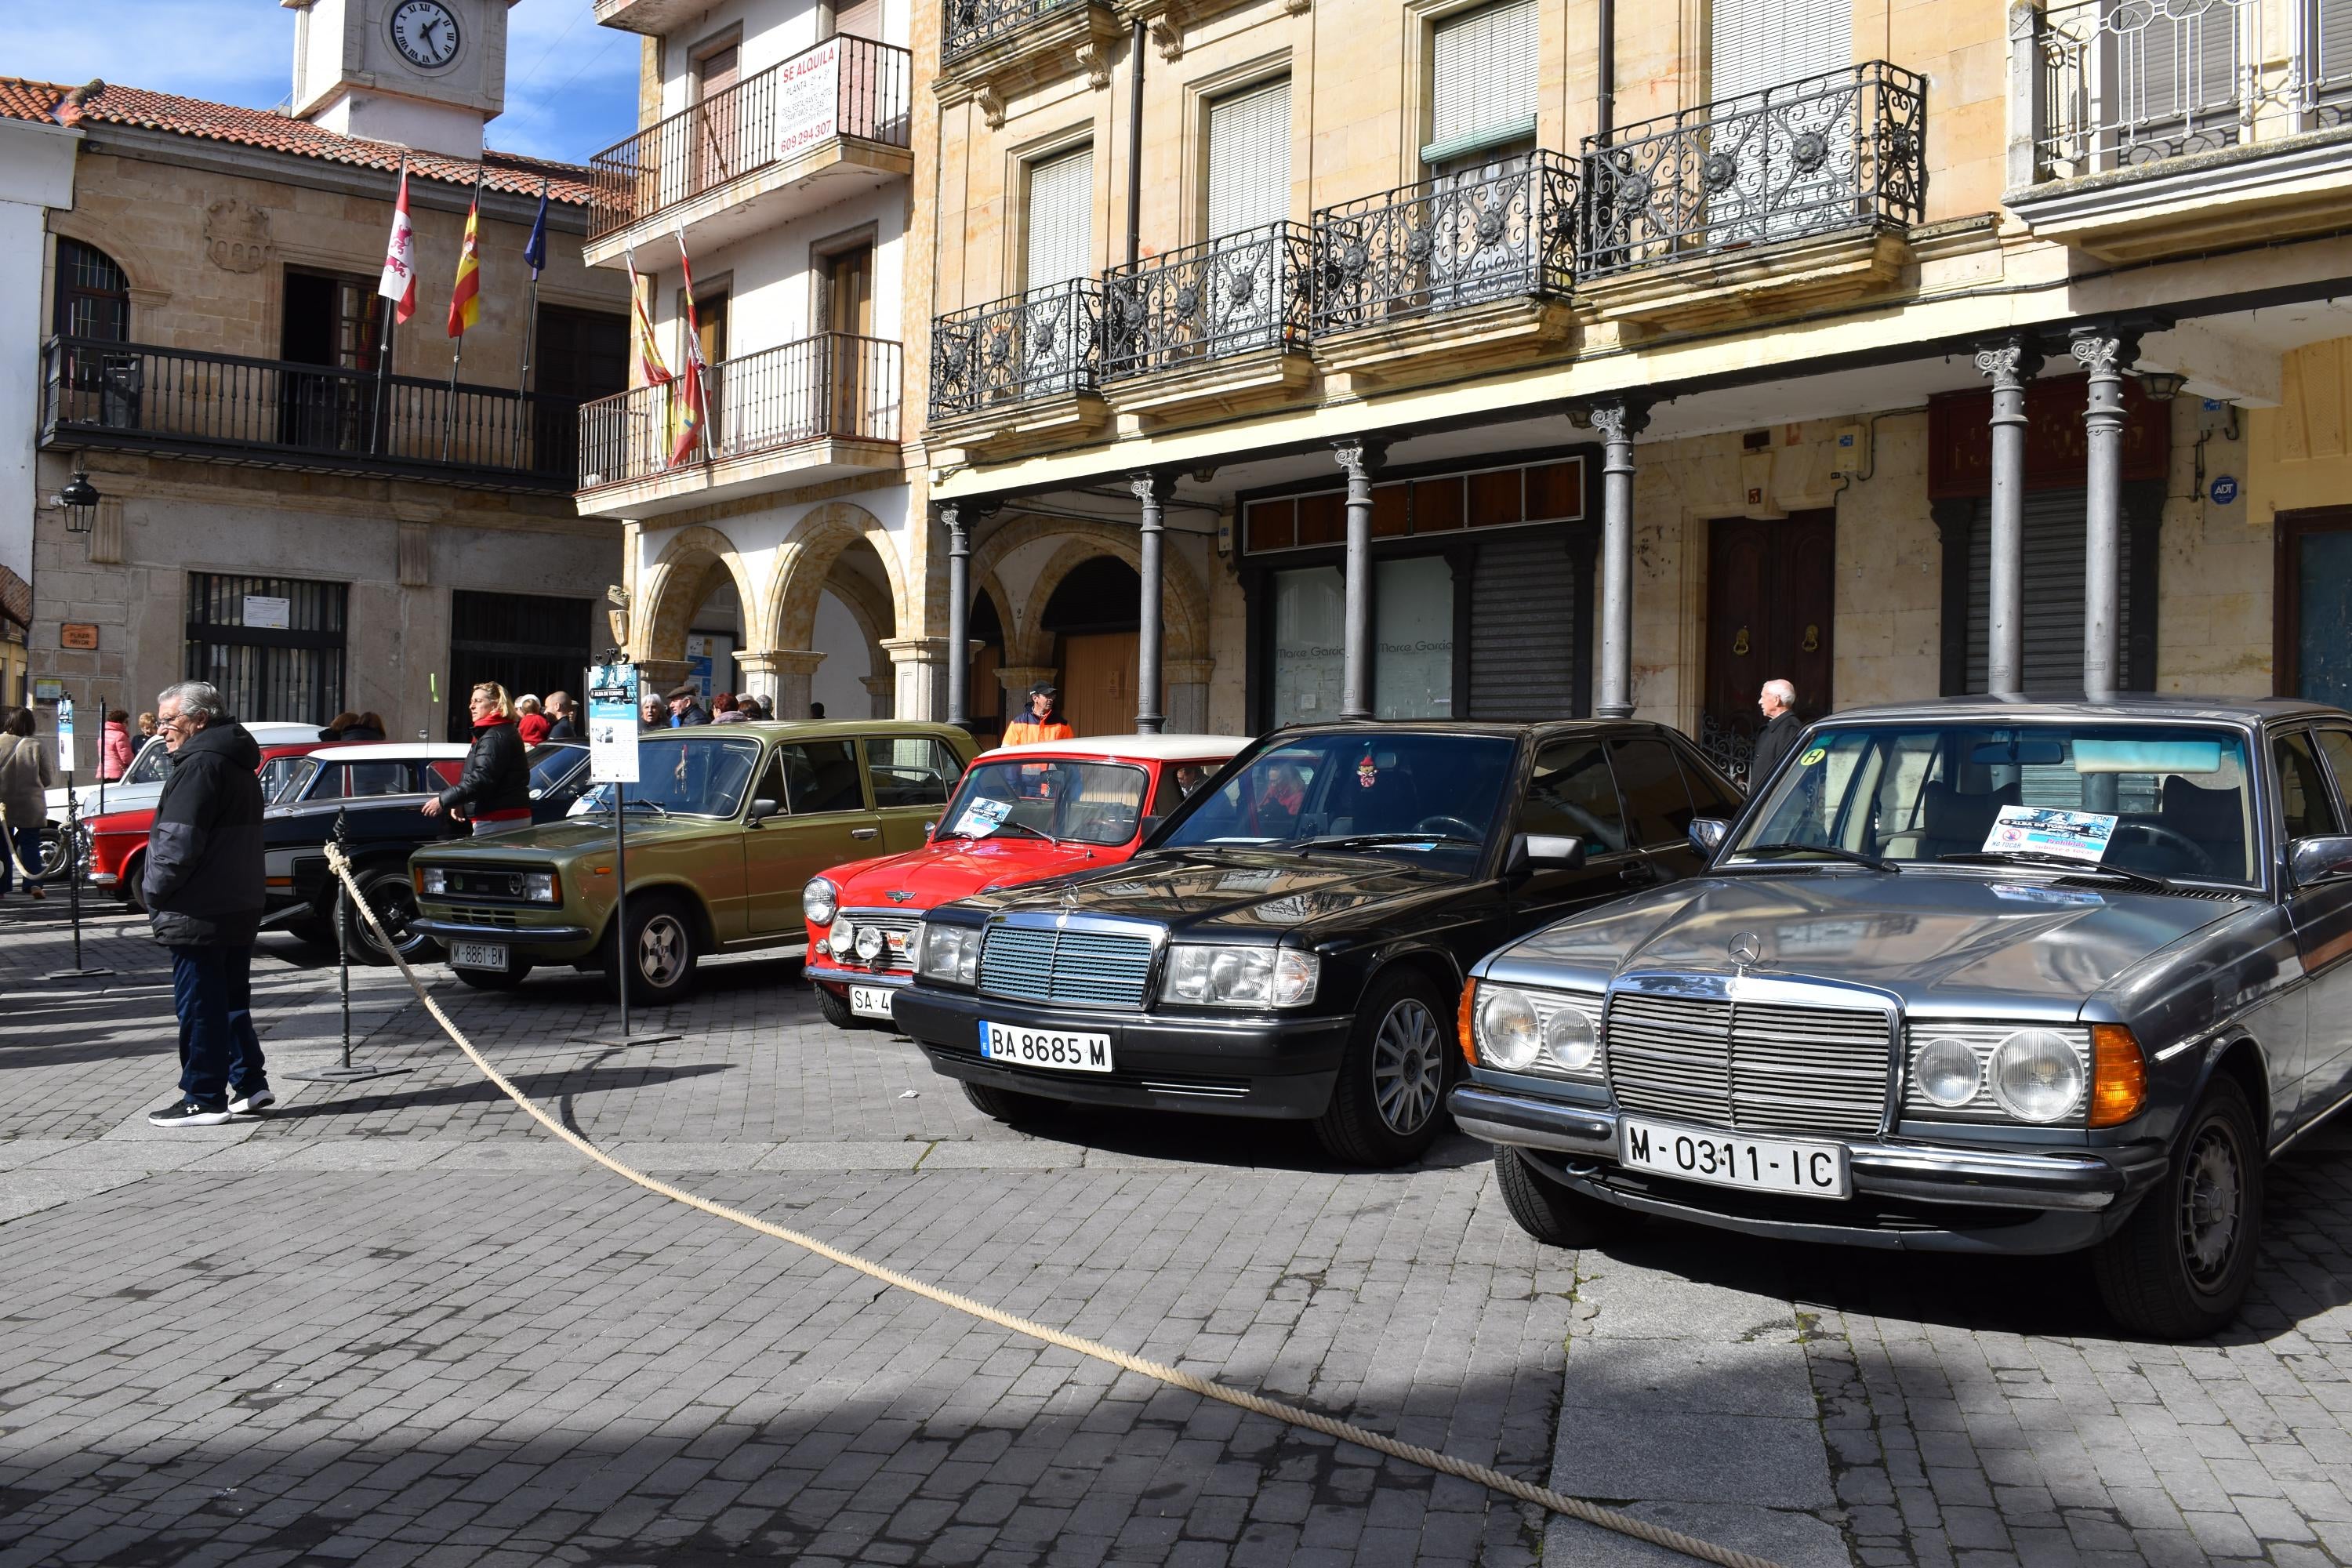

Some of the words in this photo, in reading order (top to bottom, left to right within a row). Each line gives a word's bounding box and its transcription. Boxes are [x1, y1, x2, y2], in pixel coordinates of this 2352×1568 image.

[783, 66, 794, 83] SE
[796, 46, 834, 78] ALQUILA
[786, 80, 808, 96] PLANTA
[781, 135, 797, 153] 609
[798, 127, 814, 145] 294
[815, 119, 832, 138] 307
[2215, 484, 2234, 495] ADT
[1378, 643, 1411, 653] Marce
[1803, 750, 1824, 763] H
[2046, 823, 2083, 832] TORMES
[2046, 838, 2086, 848] Prohibido
[982, 1042, 988, 1051] E
[992, 1028, 1017, 1058] BA
[1022, 1033, 1082, 1065] 8685
[1089, 1039, 1105, 1066] M
[1629, 1127, 1833, 1188] M-0311-IC
